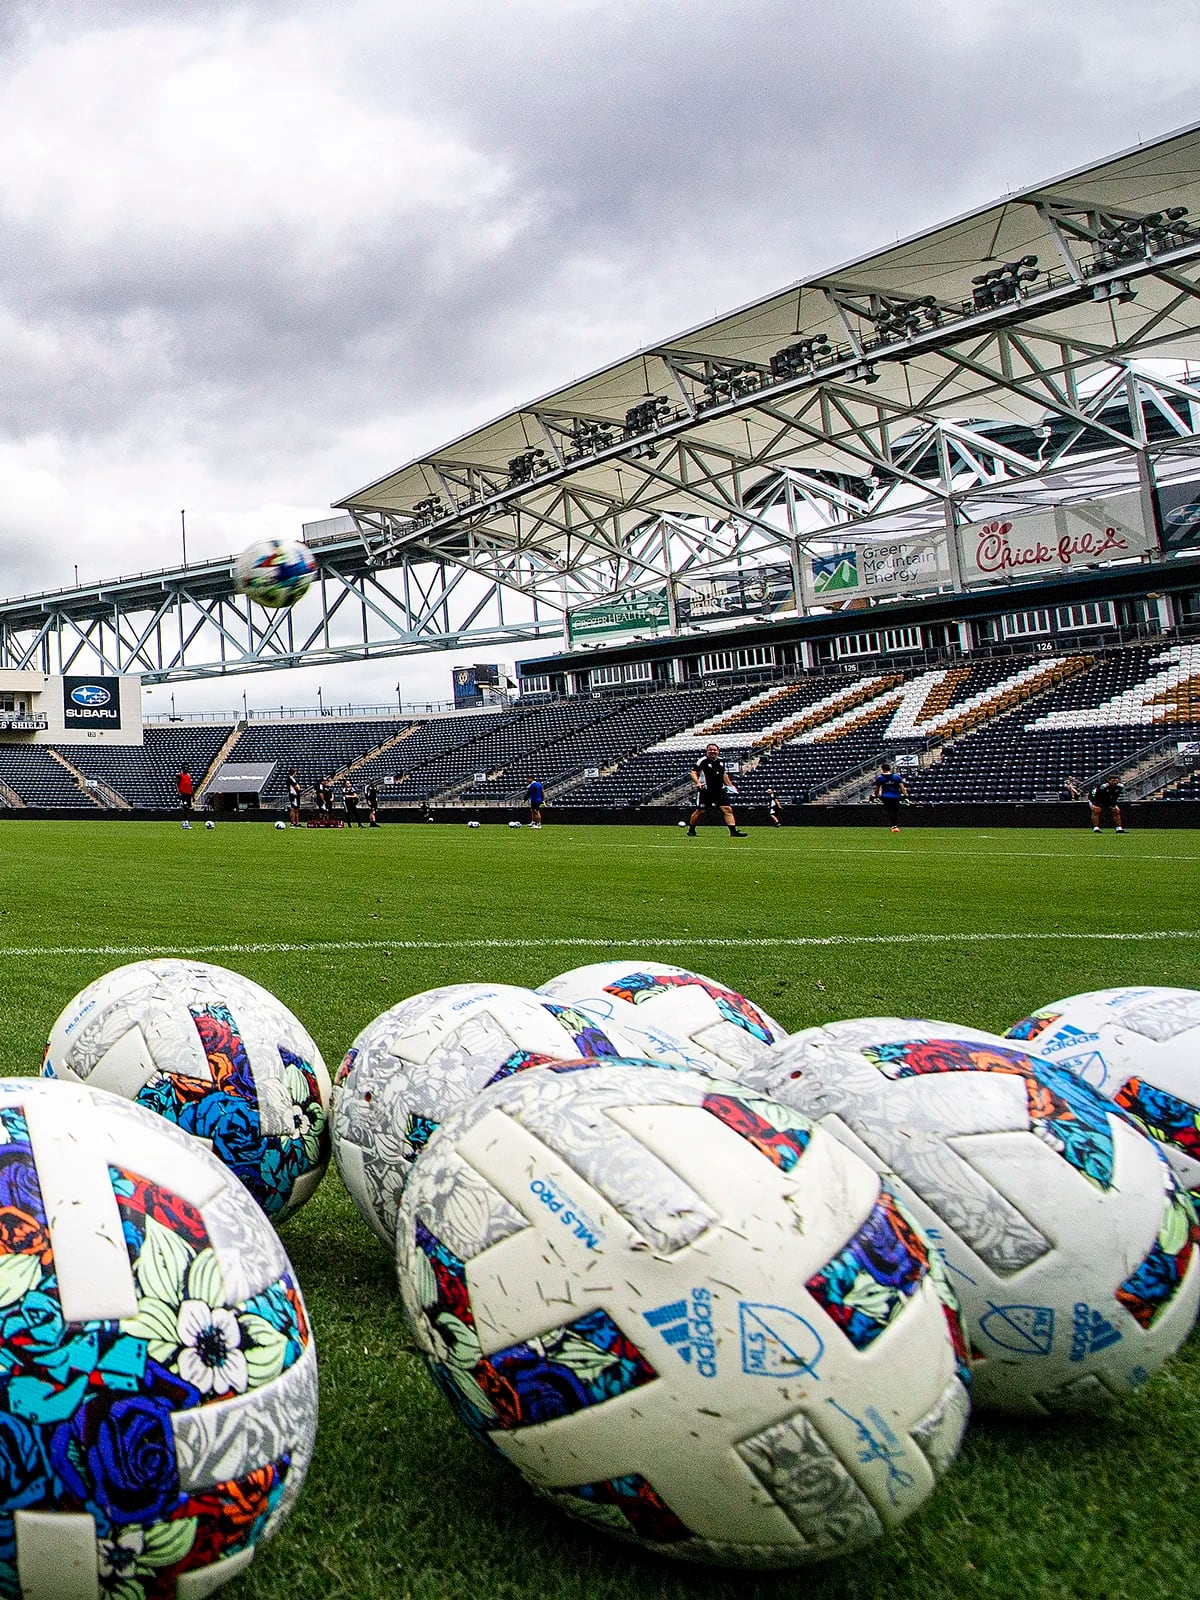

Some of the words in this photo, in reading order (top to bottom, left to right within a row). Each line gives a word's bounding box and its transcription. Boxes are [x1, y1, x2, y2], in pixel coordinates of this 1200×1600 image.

[862, 543, 908, 560] Green
[976, 524, 1128, 572] Chick-fil-A
[863, 551, 937, 573] Mountain
[865, 567, 918, 585] Energy
[1036, 643, 1053, 651] 126
[843, 664, 857, 672] 125
[11, 721, 46, 730] SHIELD
[65, 708, 118, 719] SUBARU
[1040, 1031, 1100, 1056] adidas
[530, 1180, 565, 1213] PRO
[560, 1211, 598, 1249] MLS
[689, 1287, 717, 1379] adidas
[1033, 1311, 1051, 1337] MLS
[1068, 1302, 1091, 1363] adidas
[748, 1331, 767, 1369] MLS
